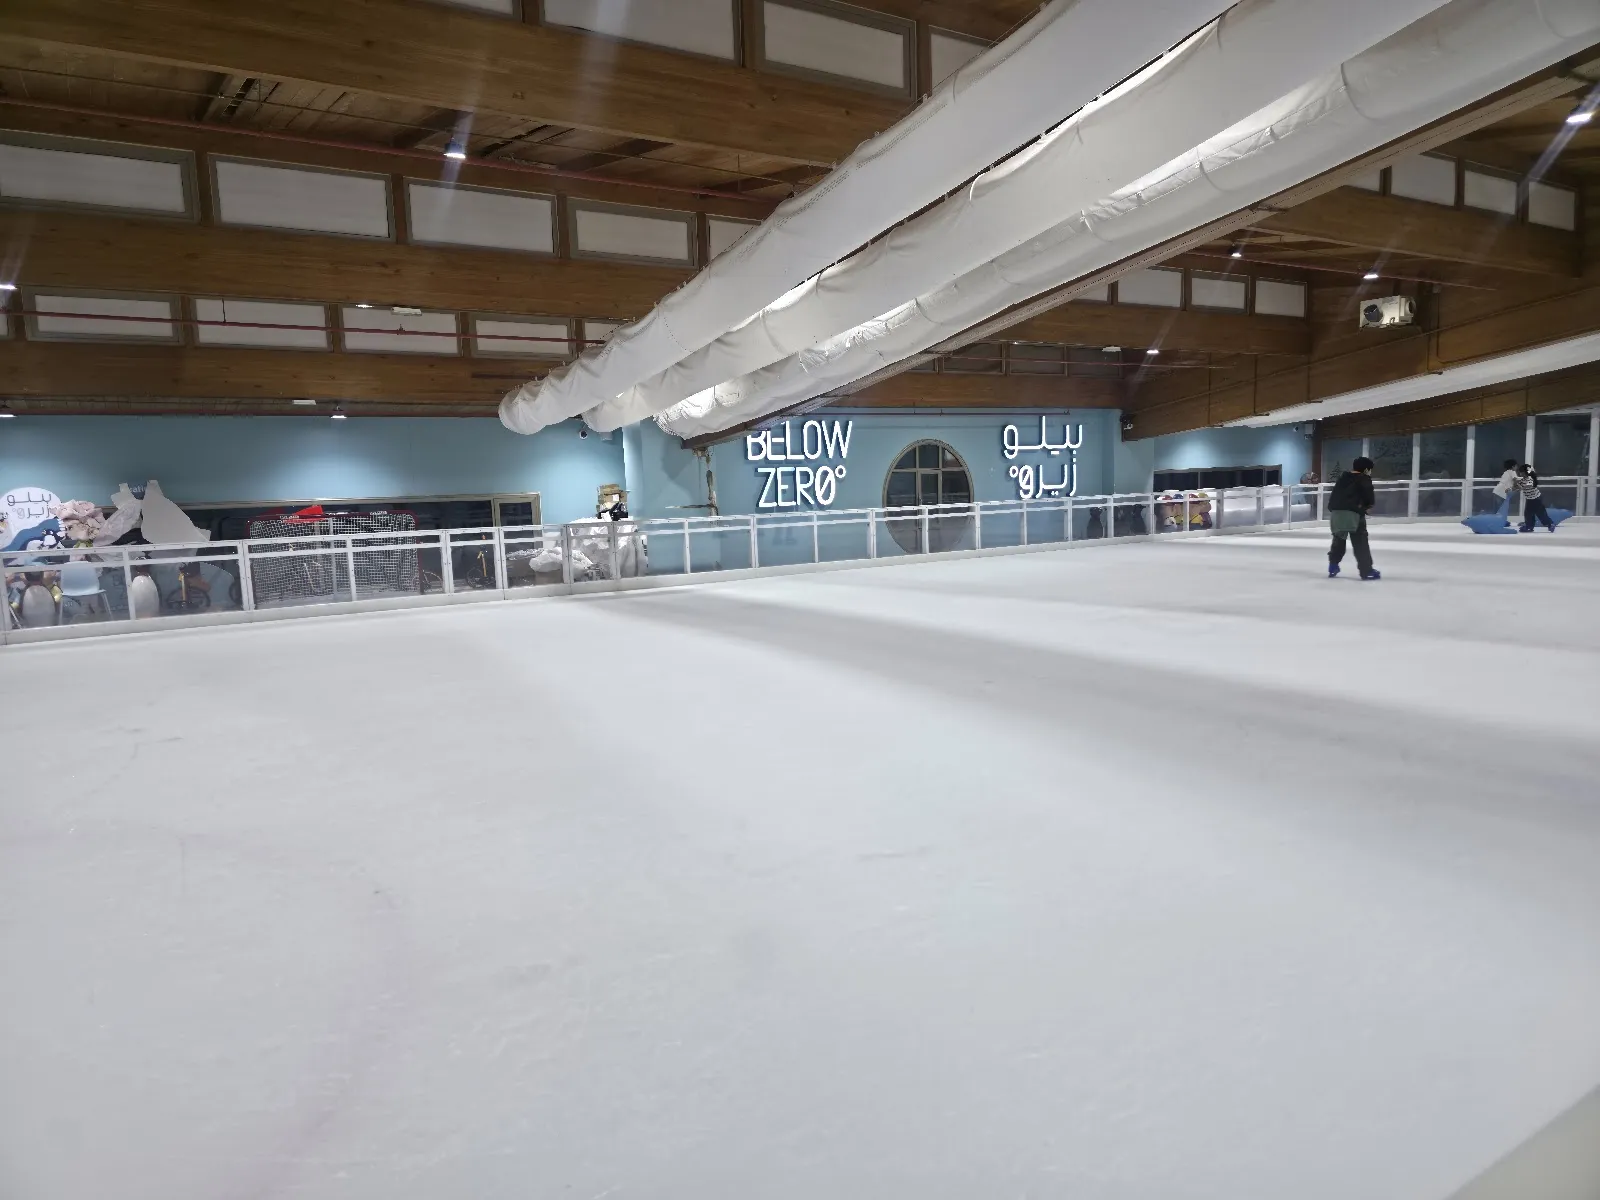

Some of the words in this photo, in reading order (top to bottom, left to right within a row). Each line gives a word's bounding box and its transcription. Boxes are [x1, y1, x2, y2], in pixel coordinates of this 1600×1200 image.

[746, 420, 853, 461] BELOW
[1003, 415, 1083, 460] بيلو
[6, 491, 52, 507] بيلو
